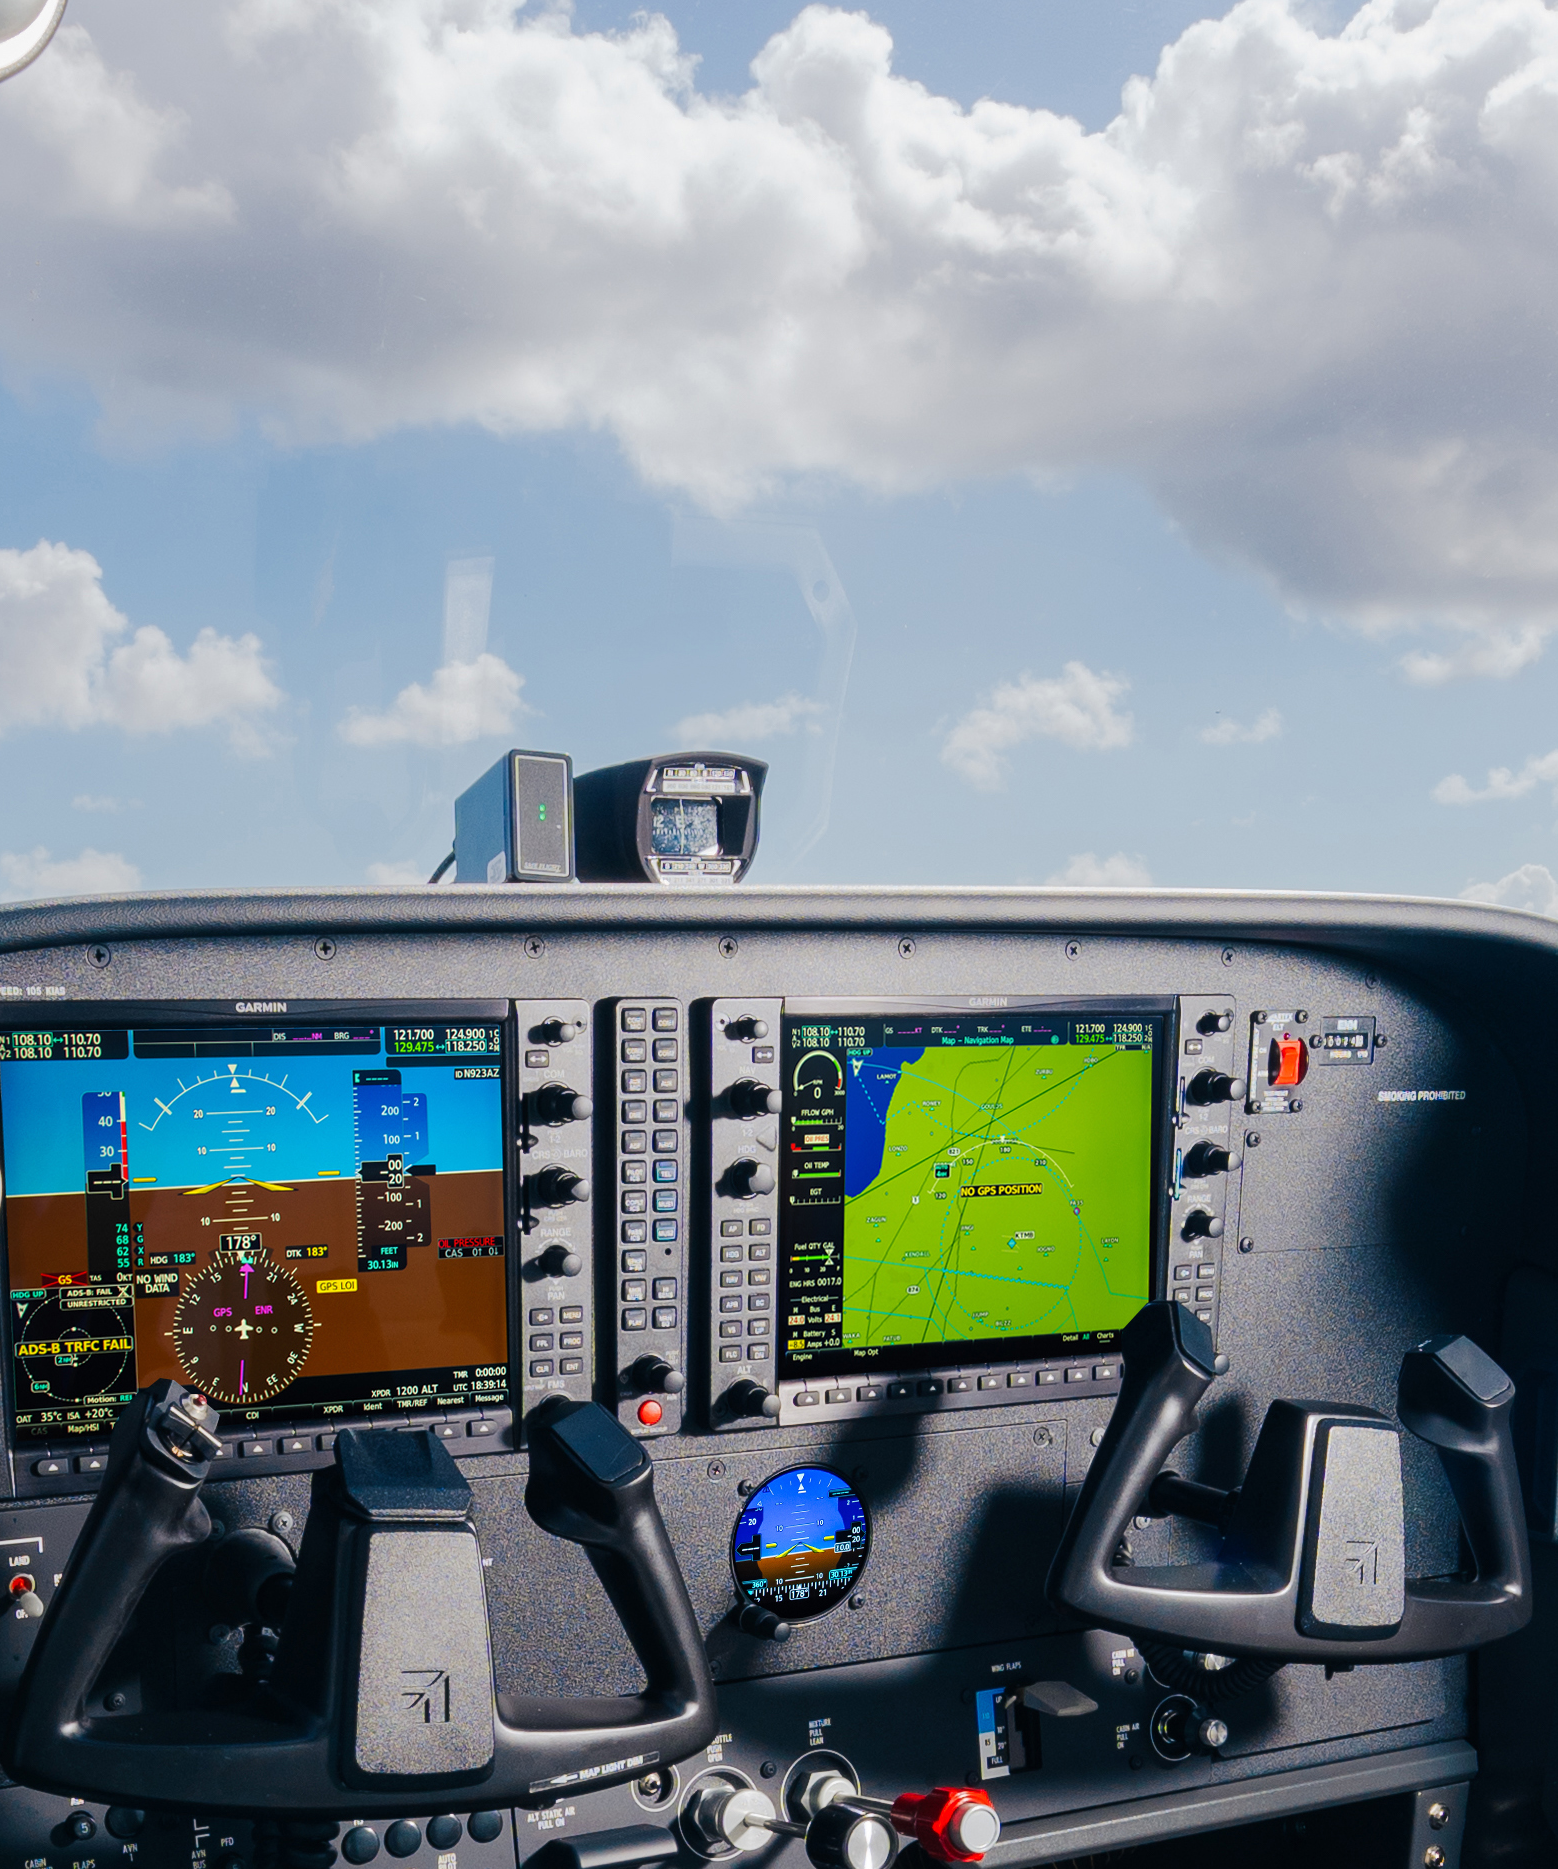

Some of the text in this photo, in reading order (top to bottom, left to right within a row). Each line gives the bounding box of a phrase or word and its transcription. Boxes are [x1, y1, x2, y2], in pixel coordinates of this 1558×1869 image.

[45, 986, 65, 996] KIAS
[969, 998, 1007, 1006] GARMIN
[235, 1002, 287, 1013] GARMIN
[803, 1027, 865, 1036] 108.10 110.70
[1076, 1024, 1142, 1033] 121.700 124.900
[393, 1028, 485, 1040] 121.700 124.900
[1076, 1034, 1142, 1043] 129.475 118.250
[13, 1033, 101, 1045] 108.10 110.70
[803, 1038, 865, 1047] 108.10 110.70
[942, 1036, 1014, 1045] Map Navigation Map
[394, 1041, 485, 1052] 129.475 118.250
[14, 1047, 101, 1058] 108.10 110.70
[455, 1069, 499, 1078] ID N923AZ
[544, 1070, 564, 1079] COM
[1378, 1091, 1465, 1101] SMOKING PROHIBITED
[381, 1106, 399, 1116] 200
[98, 1116, 113, 1126] 40
[383, 1135, 400, 1144] 100
[100, 1146, 114, 1157] 30
[564, 1149, 587, 1158] BARO
[961, 1185, 1042, 1196] NO GPS POSITION
[540, 1228, 571, 1237] RANGE
[438, 1237, 495, 1248] OIL PRESSURE
[381, 1247, 398, 1255] FEET
[445, 1249, 463, 1257] CAS
[137, 1274, 178, 1284] NO WIND
[145, 1284, 170, 1293] DATA
[320, 1282, 354, 1291] GPS LOI
[67, 1299, 126, 1308] UNRESTRICTED
[214, 1308, 232, 1317] GPS
[255, 1306, 273, 1315] ENR
[19, 1339, 131, 1355] ADS-B TRFC FAIL
[793, 1353, 812, 1361] Engine
[453, 1367, 507, 1379] TMR 0:00:00
[453, 1379, 507, 1391] UTC 18:39:14
[371, 1384, 438, 1397] XPDR 1200 ALT
[437, 1395, 464, 1405] Nearest
[475, 1392, 504, 1404] Message
[246, 1411, 259, 1419] CDI
[9, 1556, 30, 1566] LAND
[991, 1662, 1021, 1672] WING FLAPS
[810, 1728, 822, 1737] PULL
[810, 1737, 824, 1746] LEAN
[708, 1752, 723, 1762] OPEN
[579, 1756, 643, 1779] MAP LIGHT DIM
[527, 1807, 575, 1823] ALT STATIC AIR
[221, 1838, 234, 1846] PFD
[192, 1850, 206, 1859] AVN
[438, 1853, 456, 1864] AUTO
[25, 1858, 46, 1869] CABIN
[73, 1860, 95, 1869] FLAPS
[193, 1860, 206, 1869] BUS
